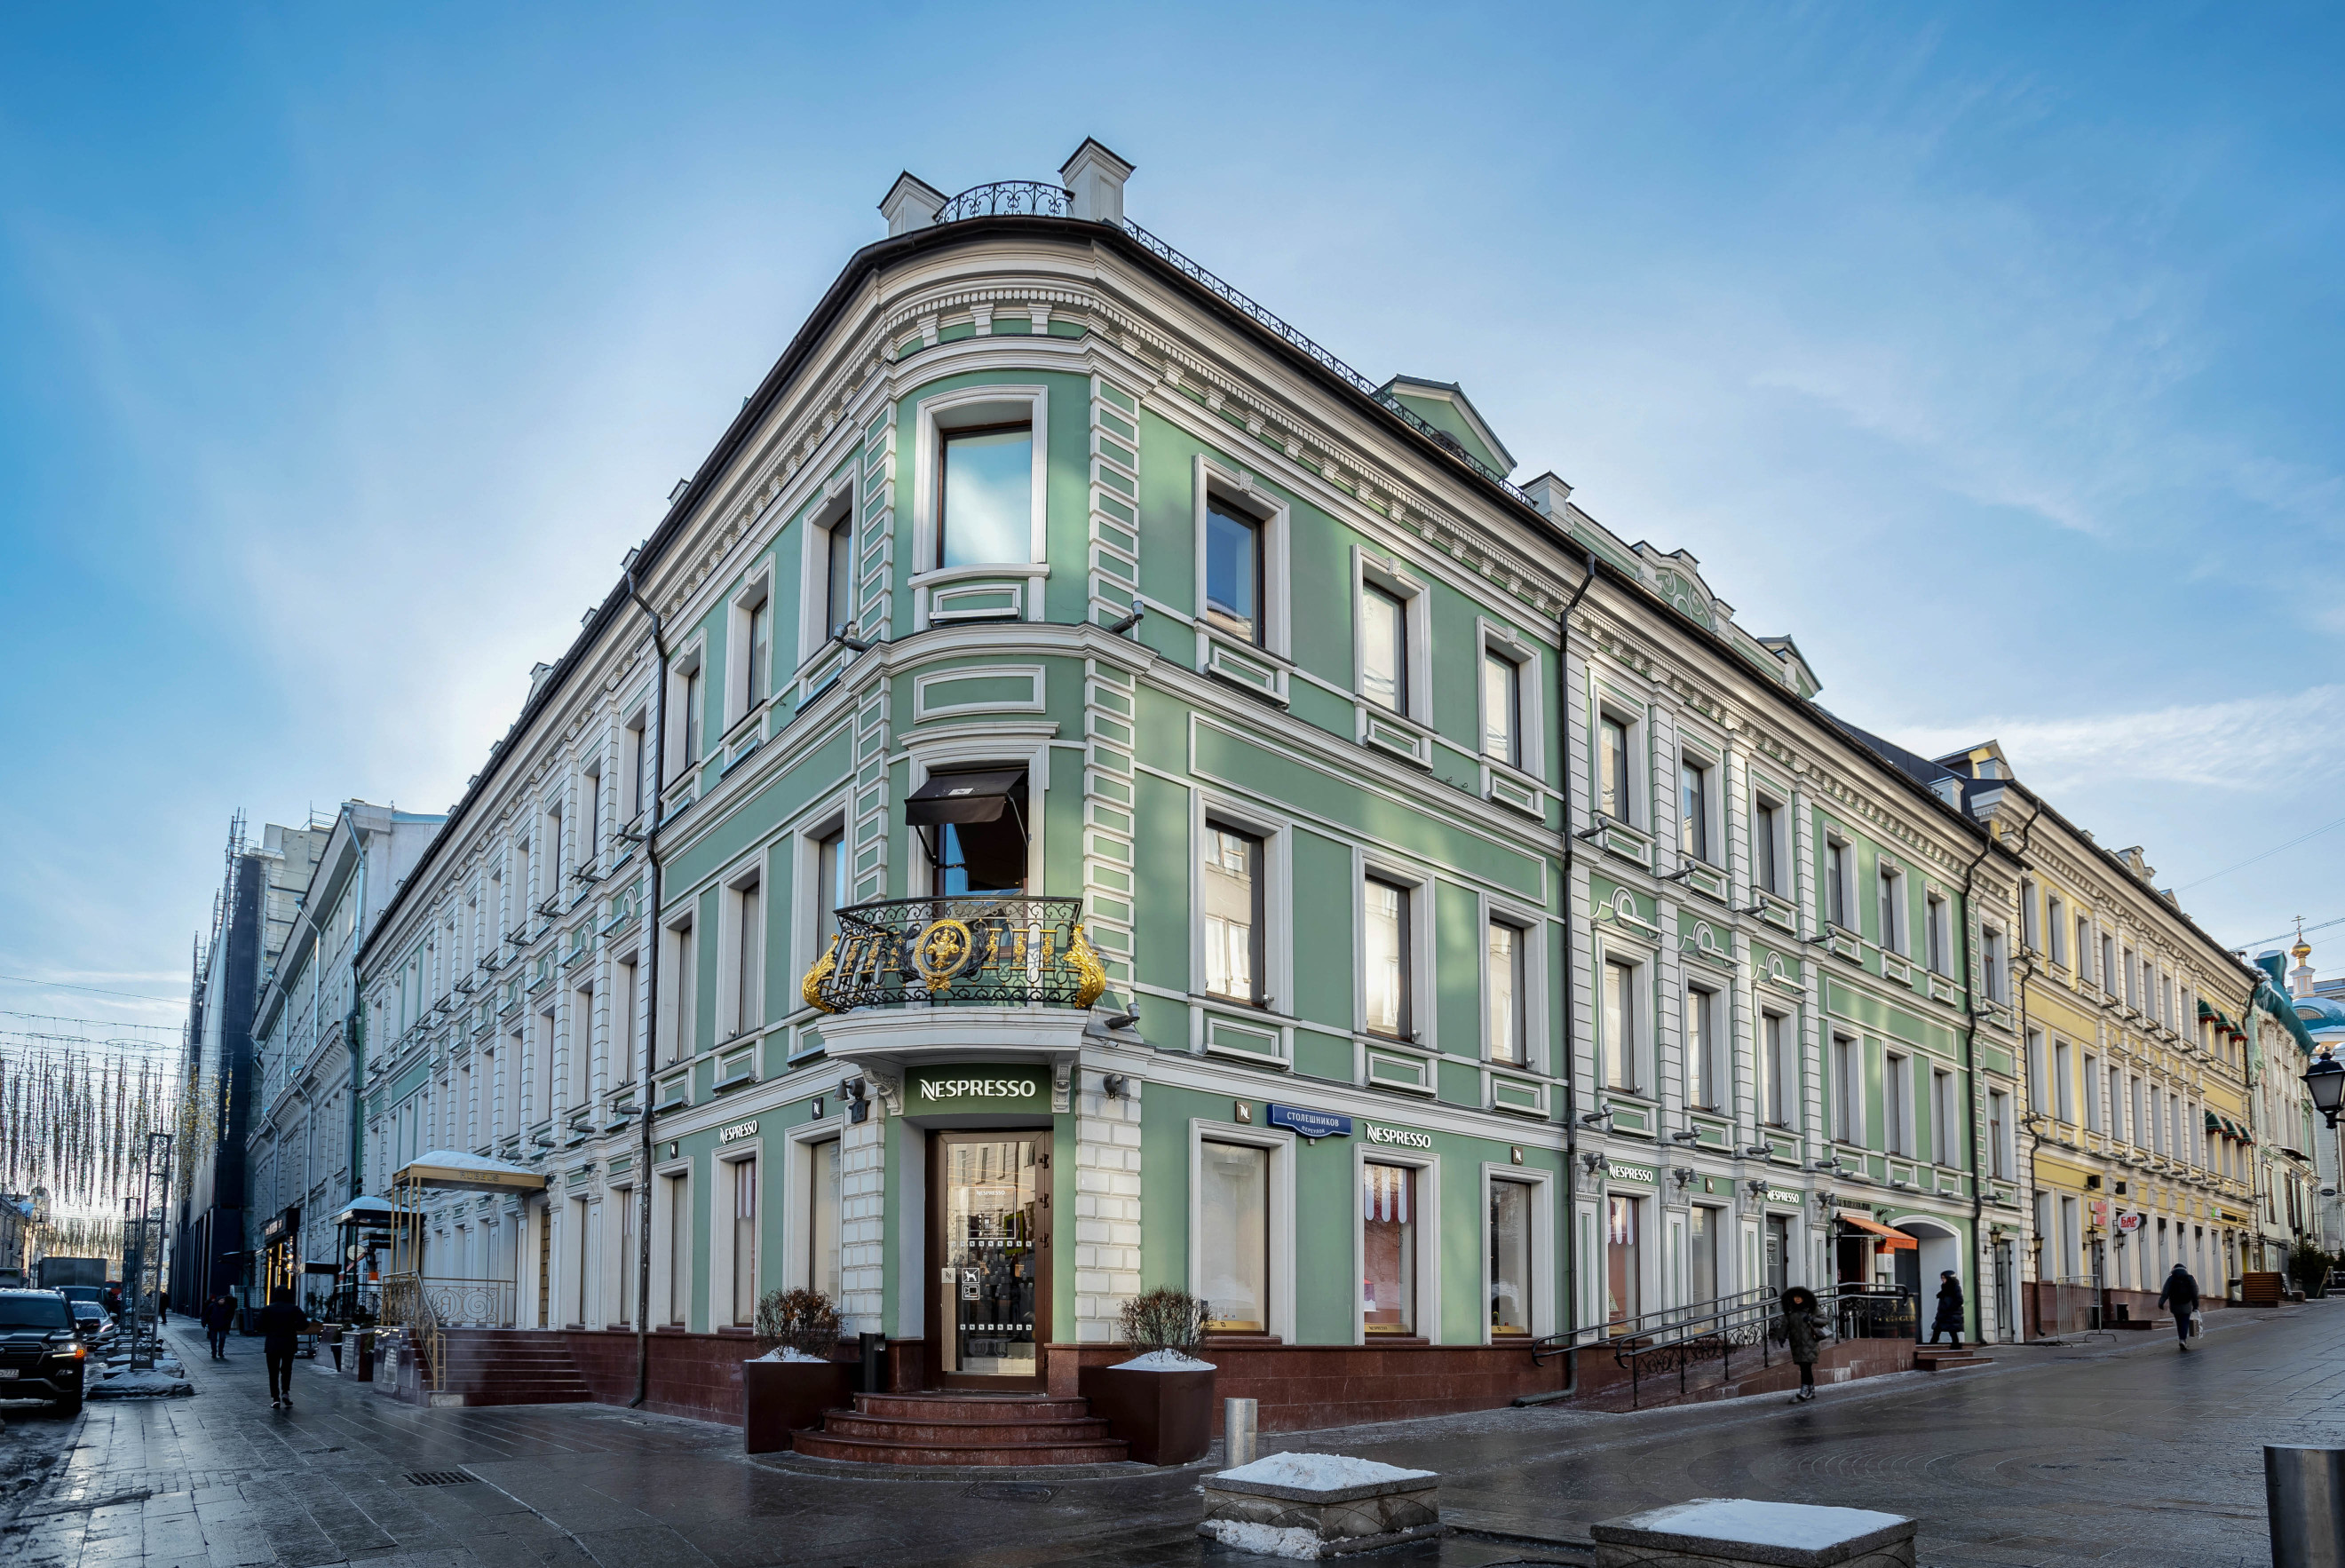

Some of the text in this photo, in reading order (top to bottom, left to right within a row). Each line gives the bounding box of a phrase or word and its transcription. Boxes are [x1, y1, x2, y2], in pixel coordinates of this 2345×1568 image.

[919, 1079, 1036, 1102] NESPRESSO
[1287, 1112, 1340, 1127] СТОЛЕШНИКОВ
[719, 1120, 758, 1144] NESPRESSO
[1301, 1125, 1326, 1135] ПЕРЕУЛОК
[1366, 1122, 1431, 1149] NESPRESSO
[1608, 1162, 1653, 1183] NESPRESSO
[1767, 1189, 1800, 1204] NESPRESSO
[2120, 1216, 2137, 1224] БАР
